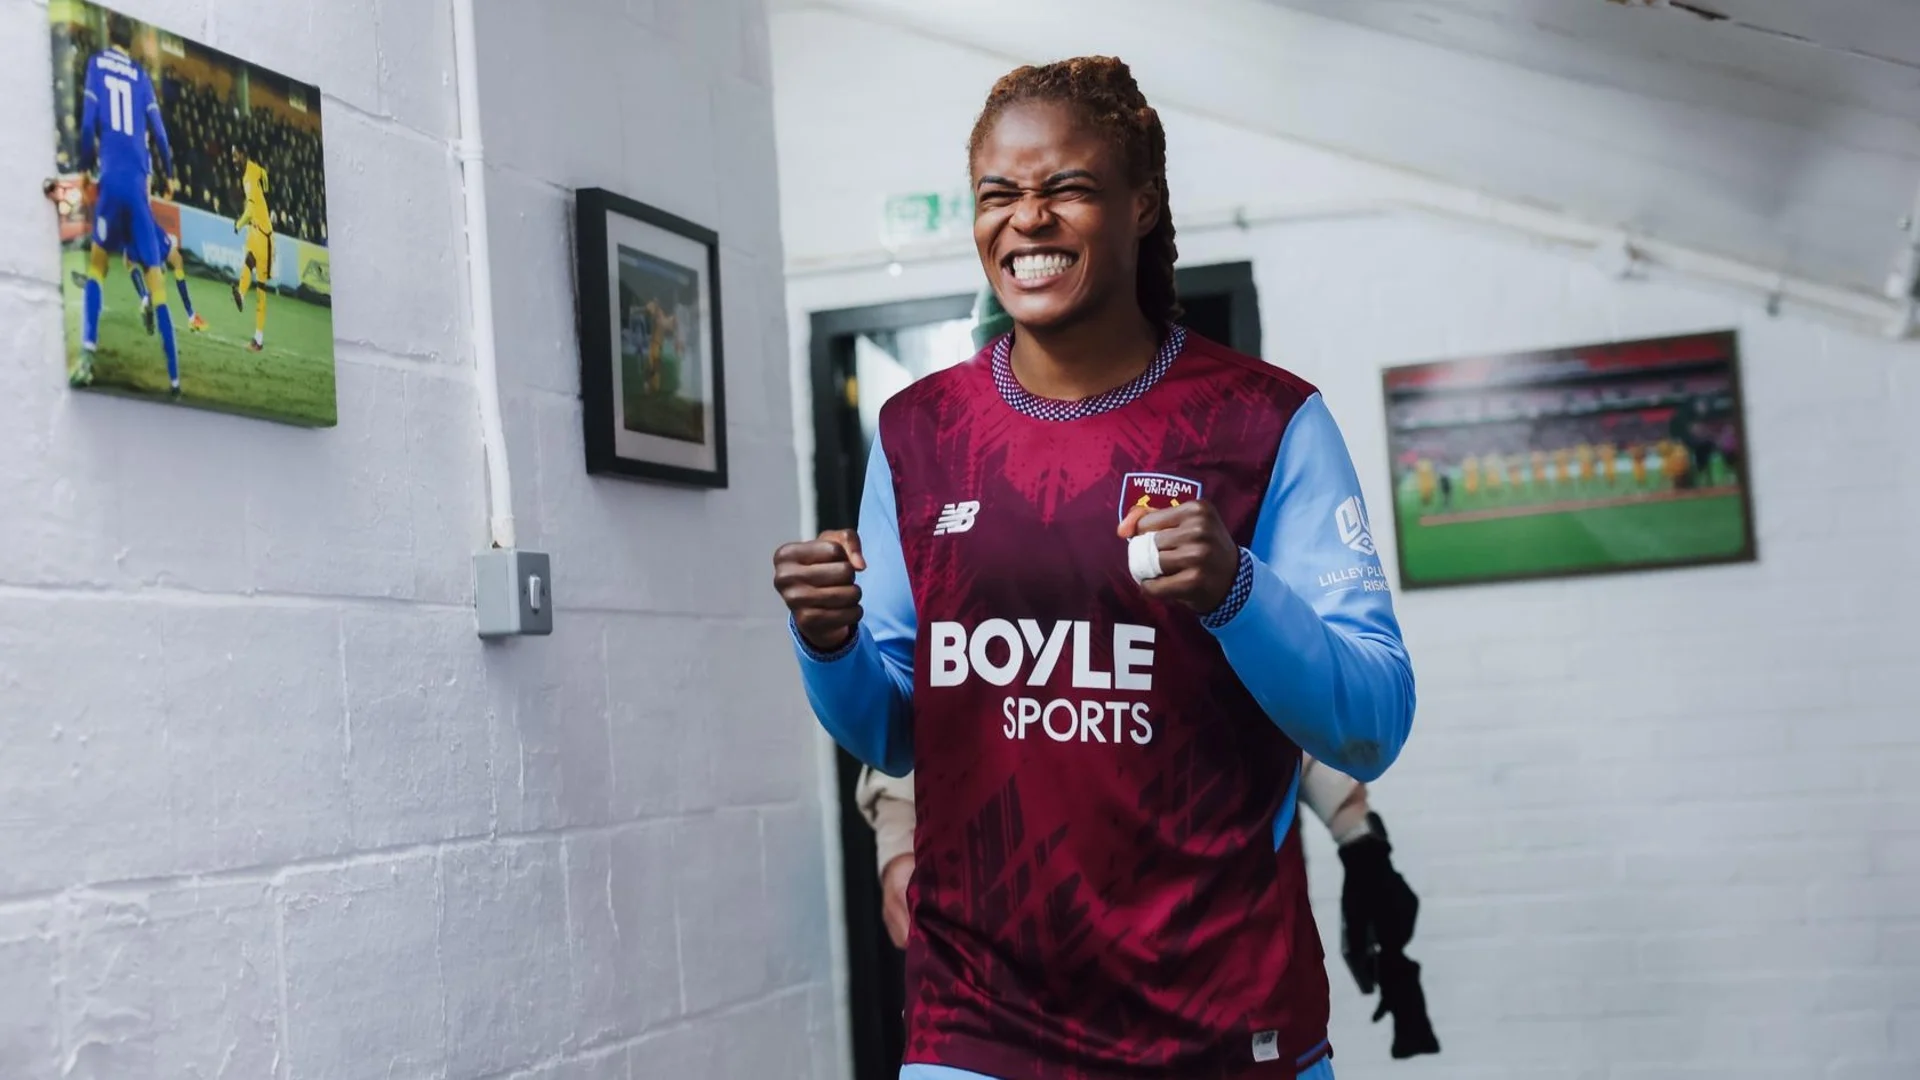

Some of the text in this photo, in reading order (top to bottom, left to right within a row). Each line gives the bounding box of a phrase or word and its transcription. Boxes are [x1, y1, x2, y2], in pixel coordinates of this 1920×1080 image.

[104, 74, 134, 136] 11
[1133, 477, 1192, 494] WEST HAM
[1144, 486, 1179, 497] UNITED
[1318, 568, 1364, 587] LILLEY
[930, 617, 1156, 691] BOYLE
[1002, 696, 1153, 745] SPORTS
